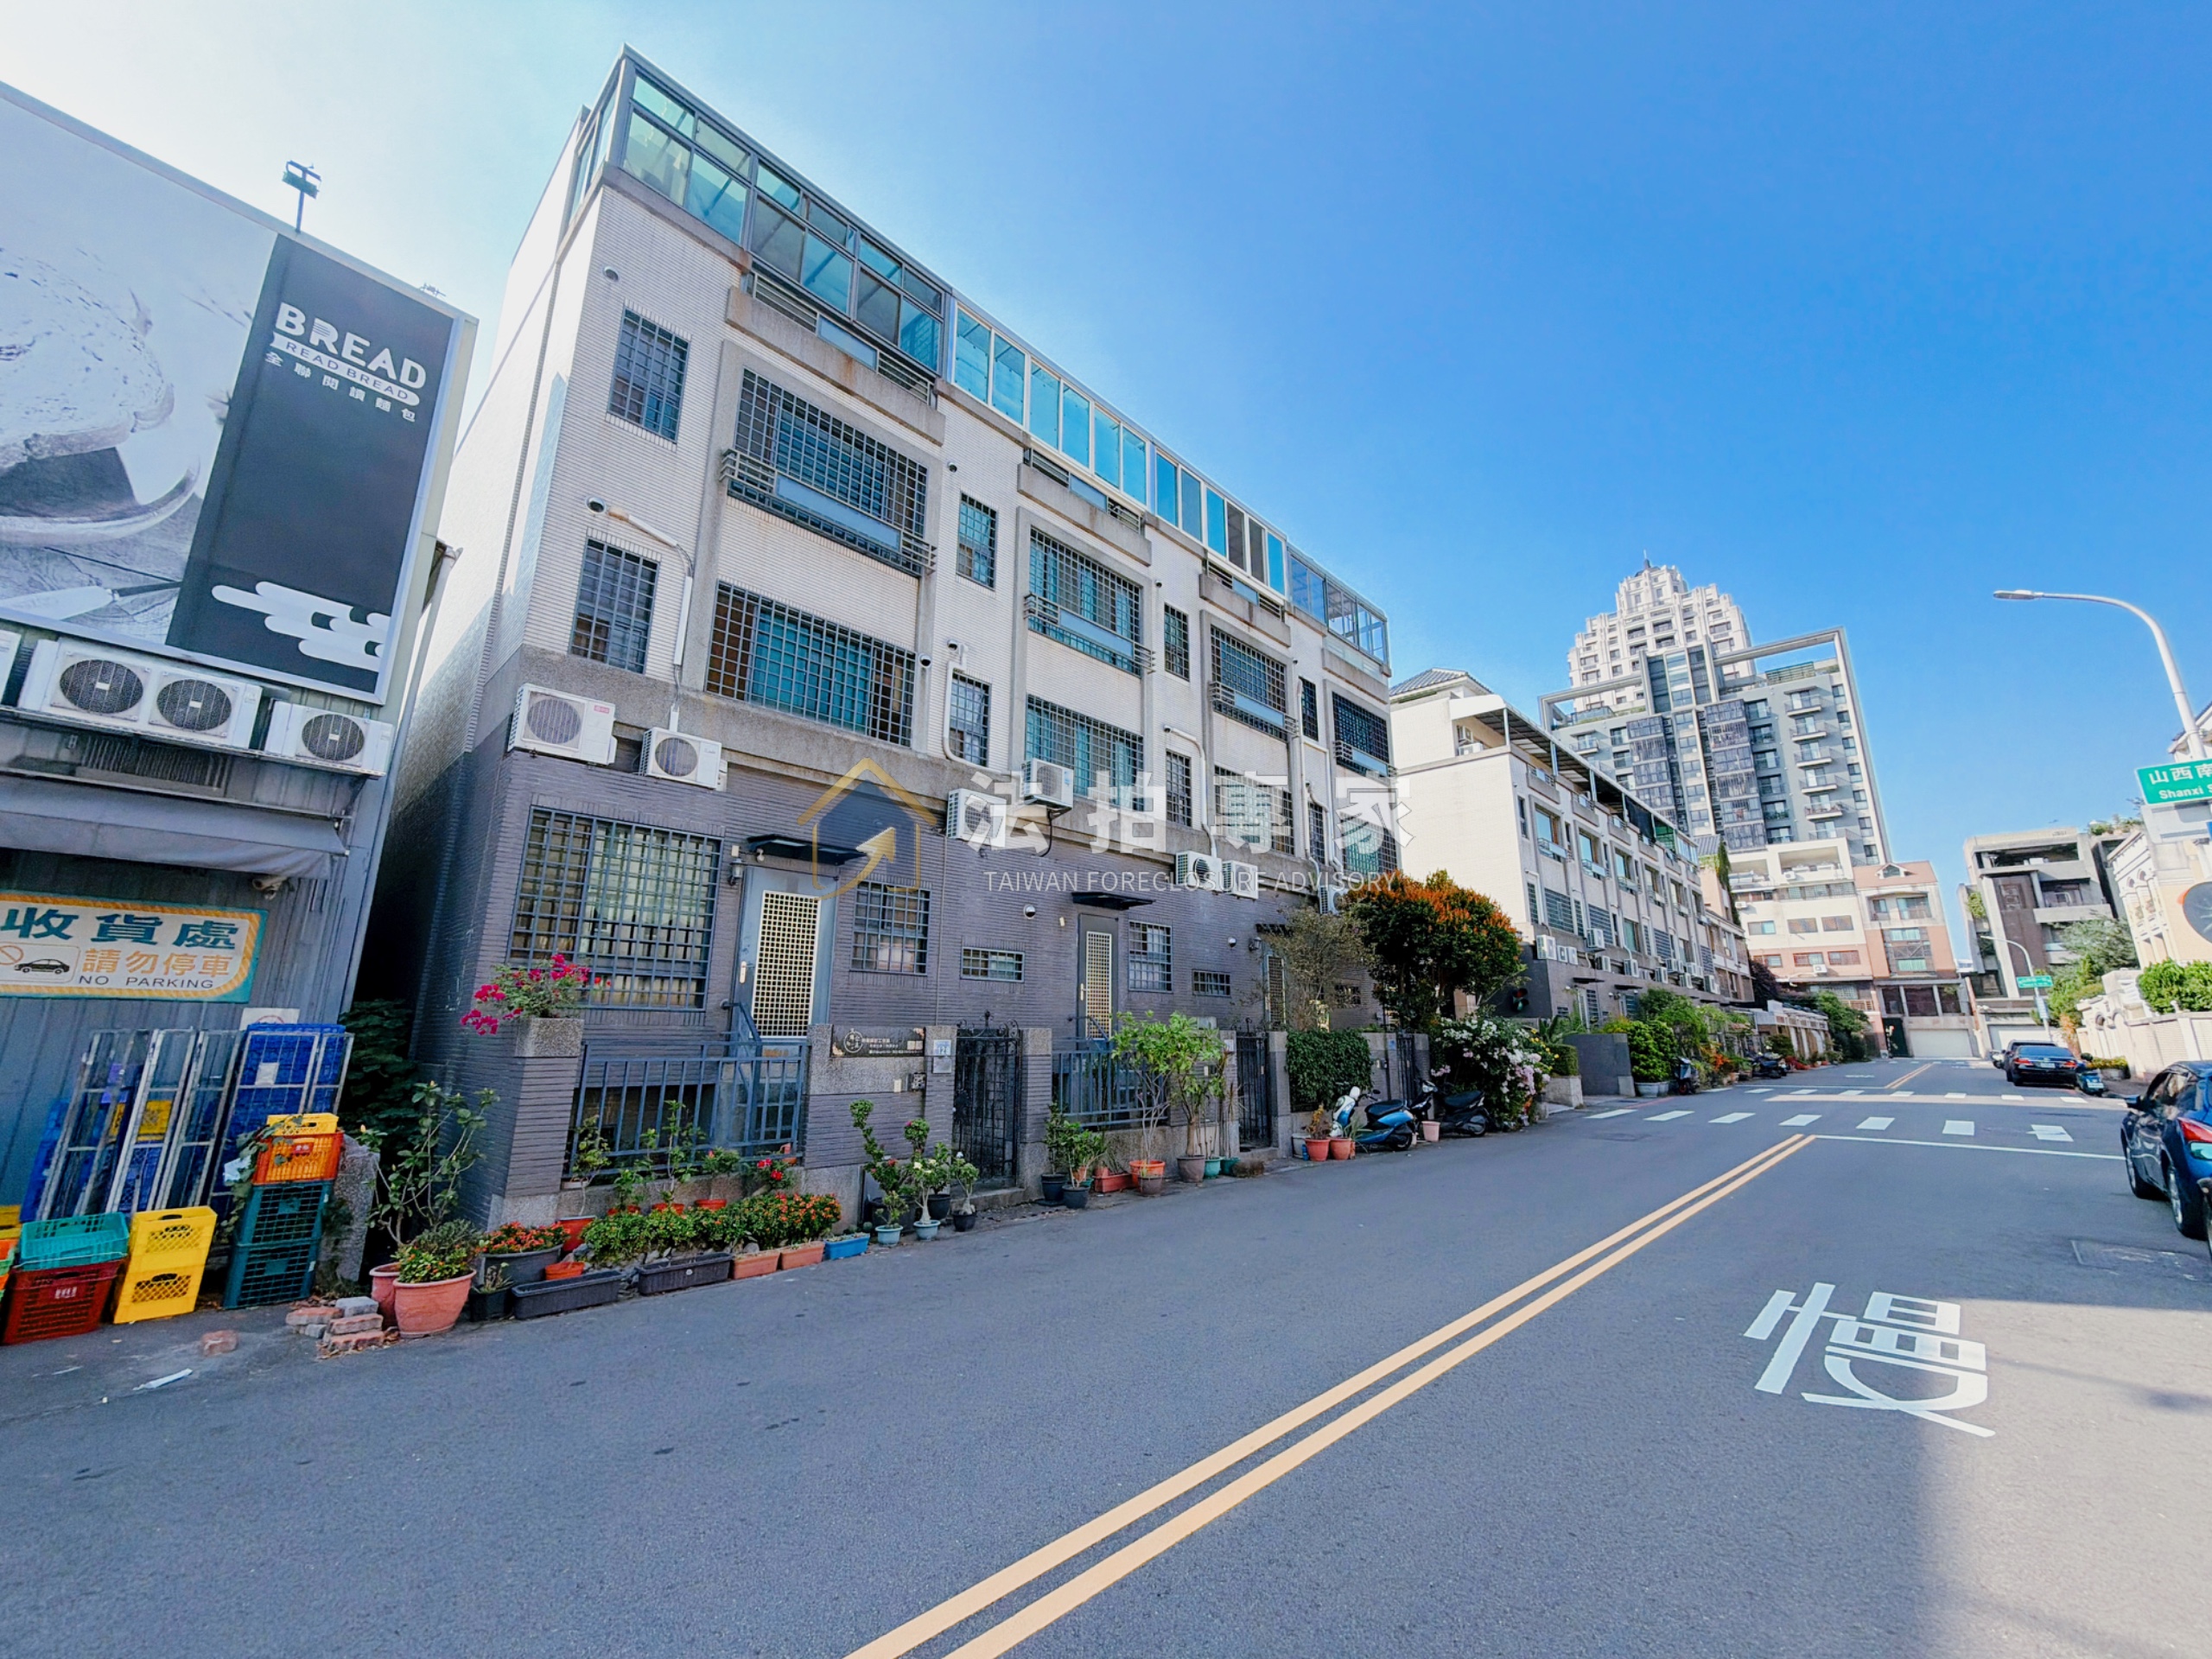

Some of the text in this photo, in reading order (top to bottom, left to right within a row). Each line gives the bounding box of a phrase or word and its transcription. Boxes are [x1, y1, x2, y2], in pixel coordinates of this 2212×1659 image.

[275, 302, 427, 389] BREAD
[286, 341, 408, 400] READ BREAD
[2158, 785, 2204, 799] Shanxi
[1, 907, 239, 950] 收貨處
[79, 975, 214, 989] NO PARKING
[81, 948, 233, 978] 請勿停車
[1743, 1281, 1996, 1438] 慢
